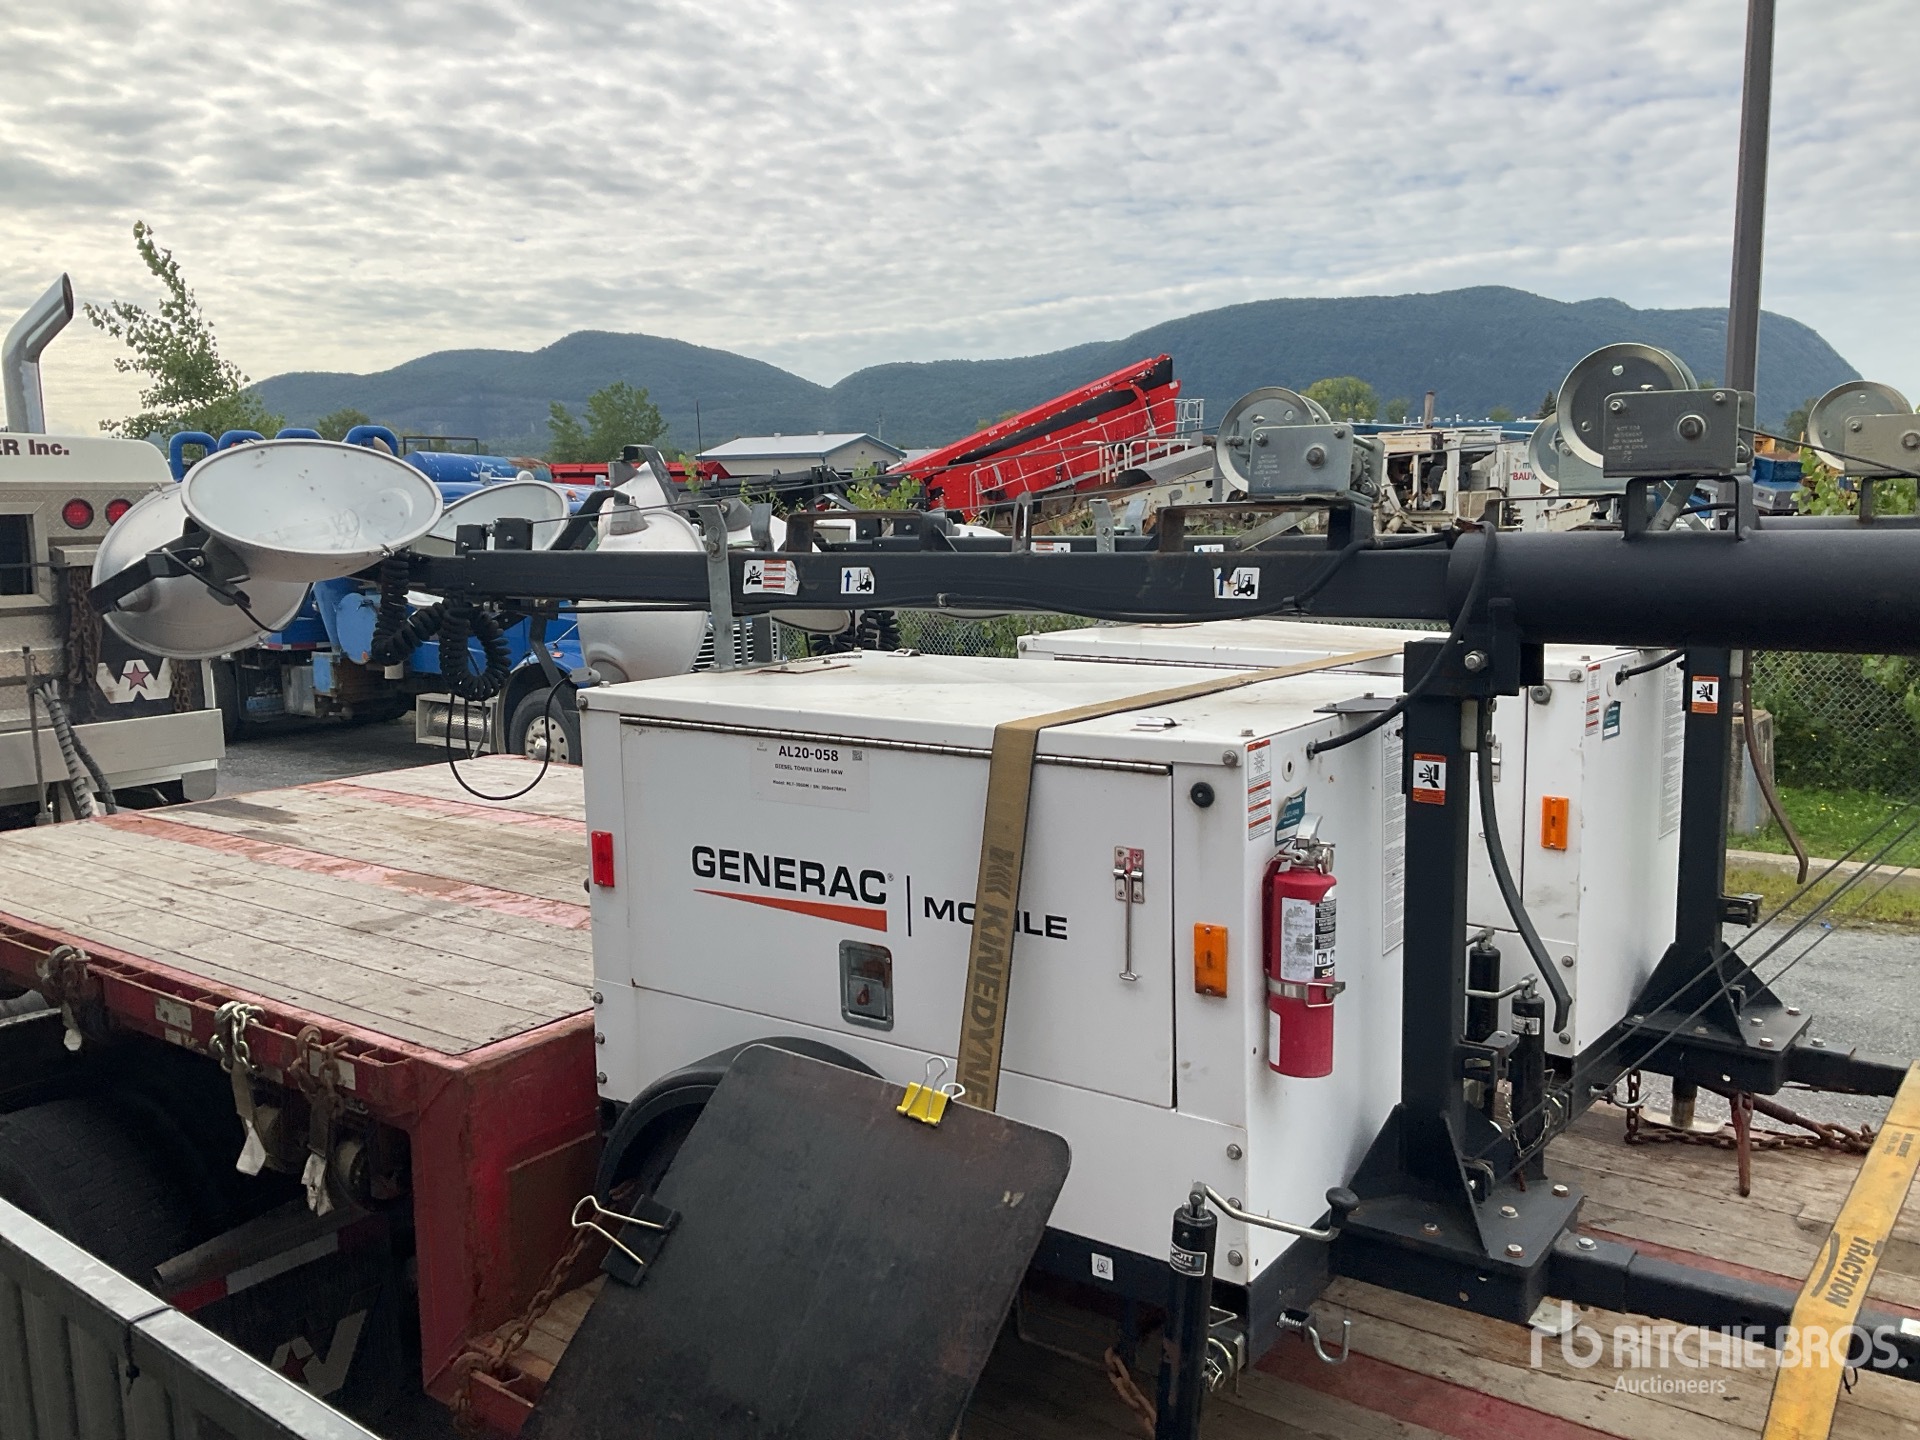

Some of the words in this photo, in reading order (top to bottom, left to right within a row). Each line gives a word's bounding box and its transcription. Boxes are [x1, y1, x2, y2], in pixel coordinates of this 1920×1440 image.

[0, 439, 20, 455] R
[28, 439, 70, 455] Inc.
[774, 763, 793, 771] DIESEL
[794, 765, 812, 773] TOWER
[778, 745, 839, 762] AL20-058
[691, 845, 887, 905] GENERAC
[924, 896, 1068, 940] MOILE
[963, 904, 1009, 1109] KINEDYNE
